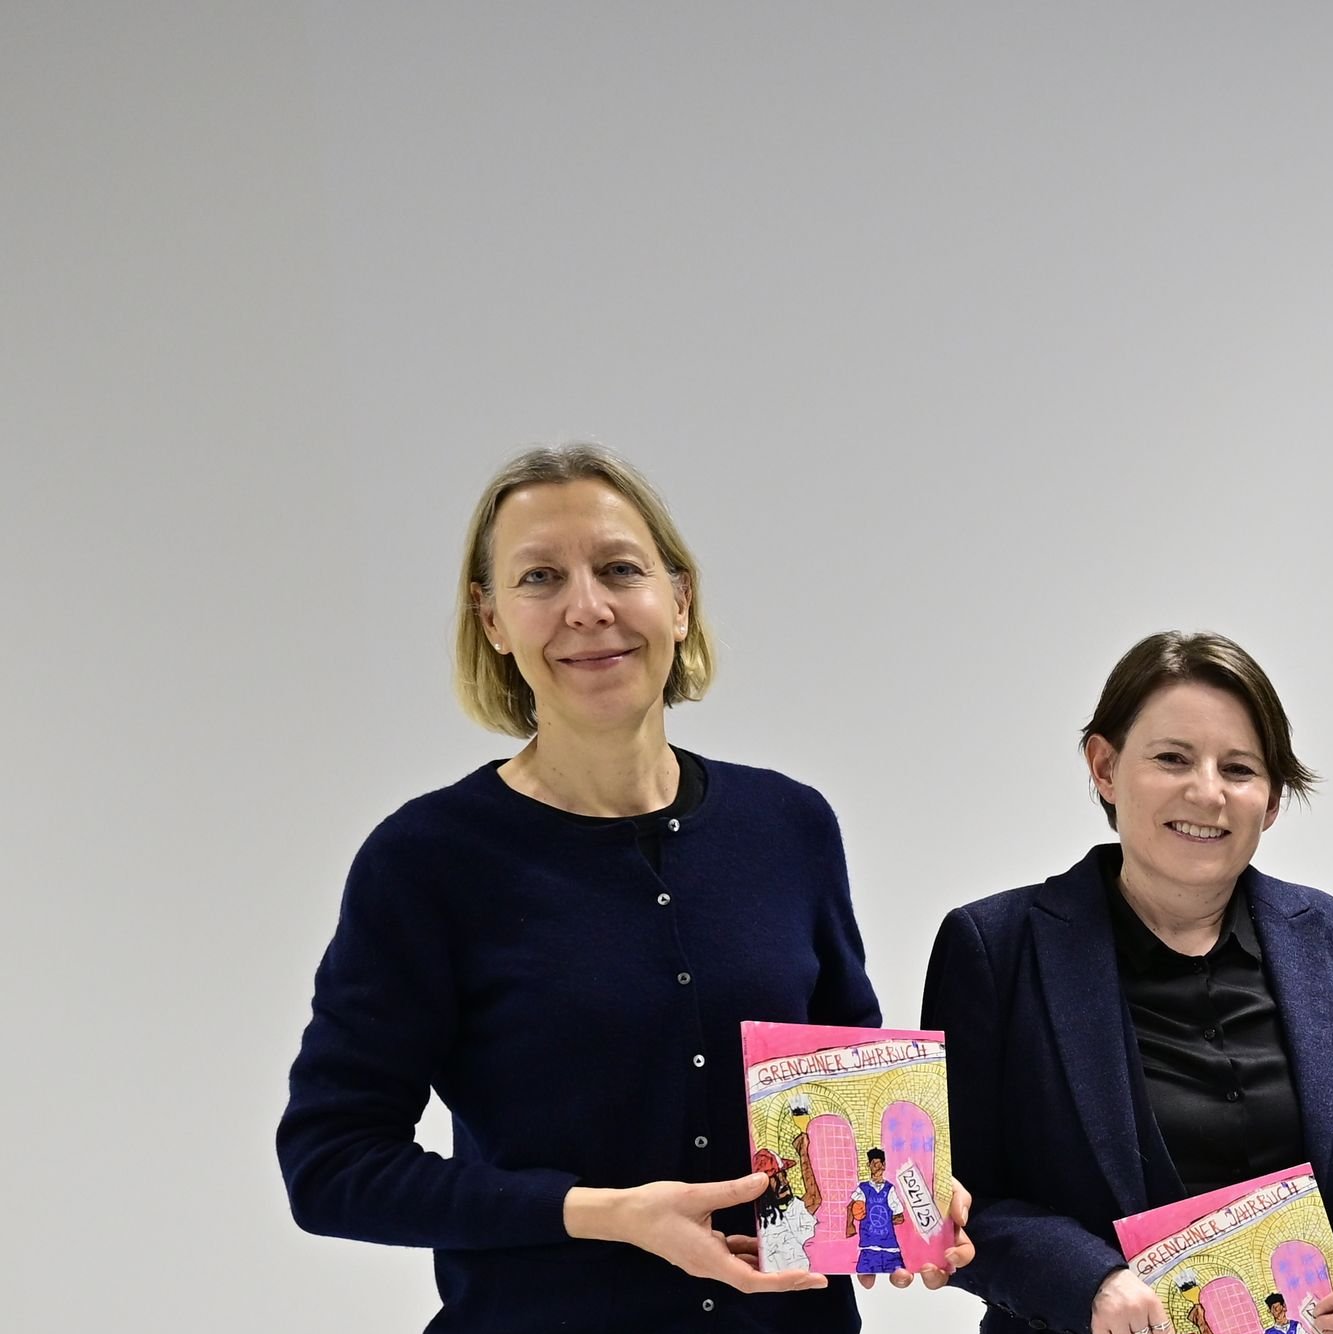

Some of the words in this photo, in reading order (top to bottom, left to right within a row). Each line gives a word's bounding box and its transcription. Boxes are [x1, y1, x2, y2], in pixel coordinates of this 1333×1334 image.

[758, 1054, 848, 1086] GRENCHNER
[852, 1043, 927, 1071] JAHRBUCH
[902, 1169, 936, 1228] 2024/25
[1136, 1219, 1227, 1276] GRENCHNER
[1228, 1181, 1301, 1226] JAHRBUCH
